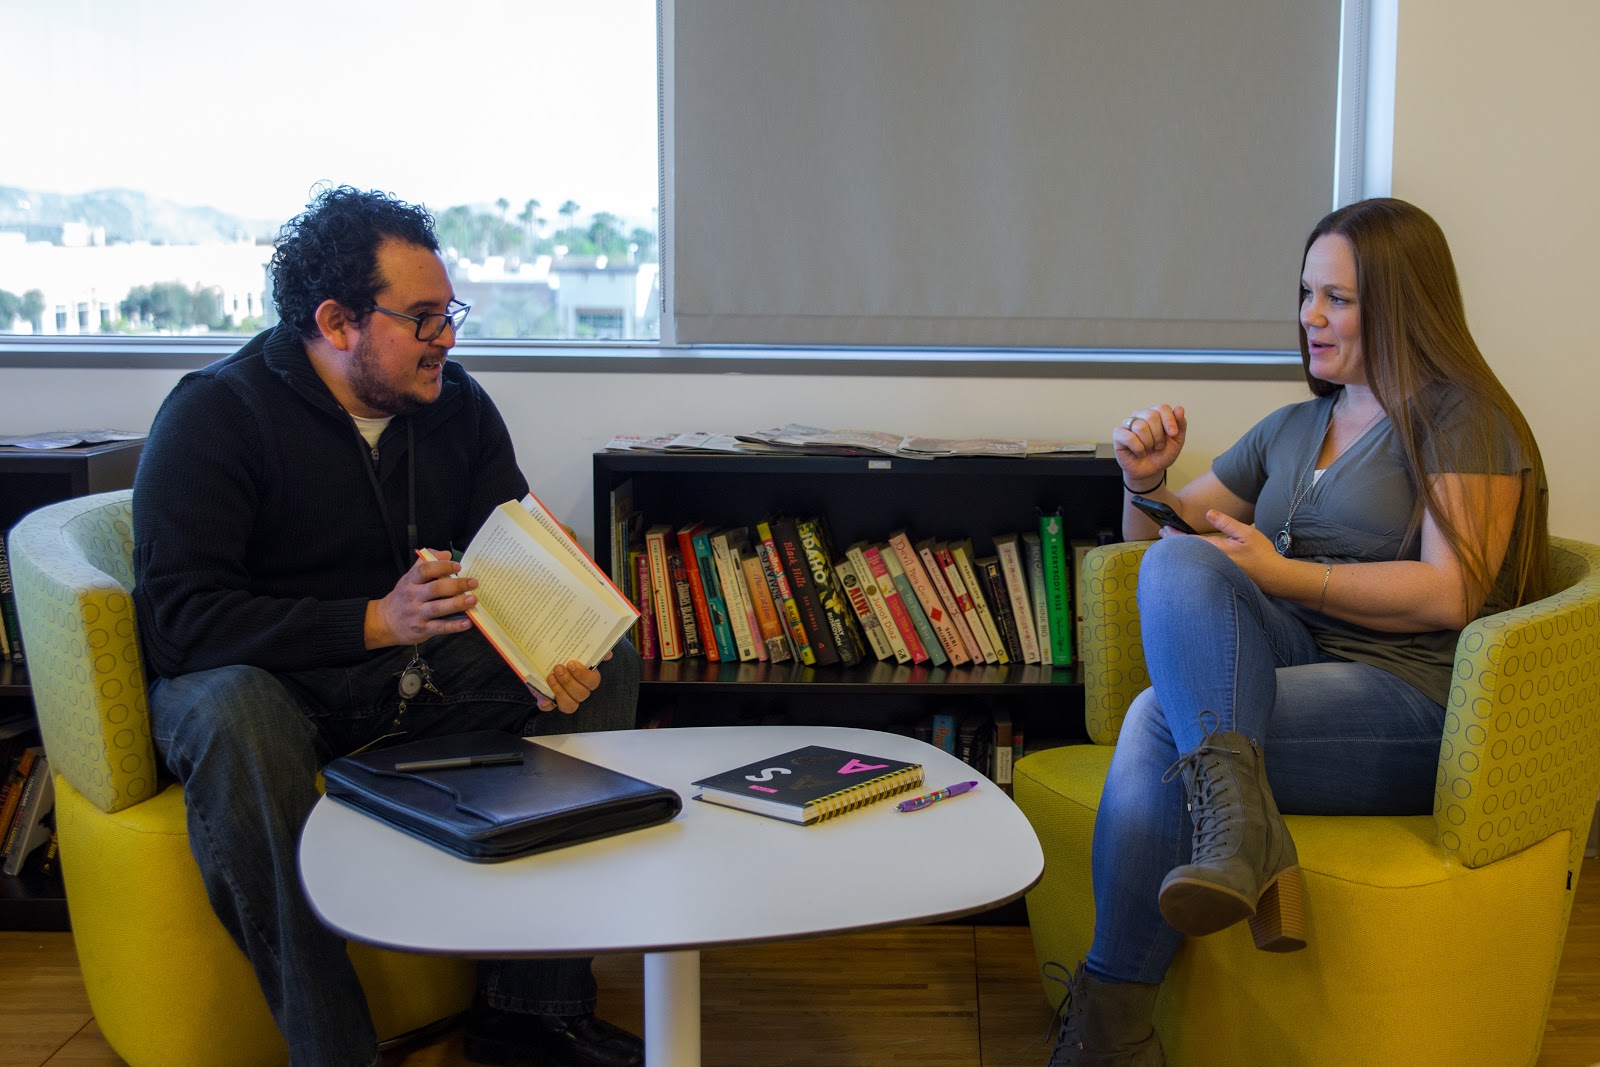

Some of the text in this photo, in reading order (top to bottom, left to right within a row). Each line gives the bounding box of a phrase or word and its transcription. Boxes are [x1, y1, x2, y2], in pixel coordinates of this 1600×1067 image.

[780, 539, 808, 588] Black Hills
[799, 530, 828, 584] IDAHO
[894, 538, 914, 566] Devil
[1032, 545, 1040, 560] BEN
[963, 564, 972, 579] PARIS
[1050, 545, 1060, 591] EVERYBODY
[774, 570, 792, 599] Vitamin
[680, 605, 694, 624] BLACK
[847, 585, 871, 618] ALIVE
[826, 611, 842, 646] RUSKOVICH
[834, 618, 844, 636] EMILY
[871, 595, 888, 620] Junot
[883, 620, 898, 640] Díaz
[1037, 600, 1048, 637] THINK BIG
[935, 625, 954, 654] McINNIS
[943, 626, 958, 647] SHERI
[745, 767, 792, 782] S
[837, 759, 889, 774] A
